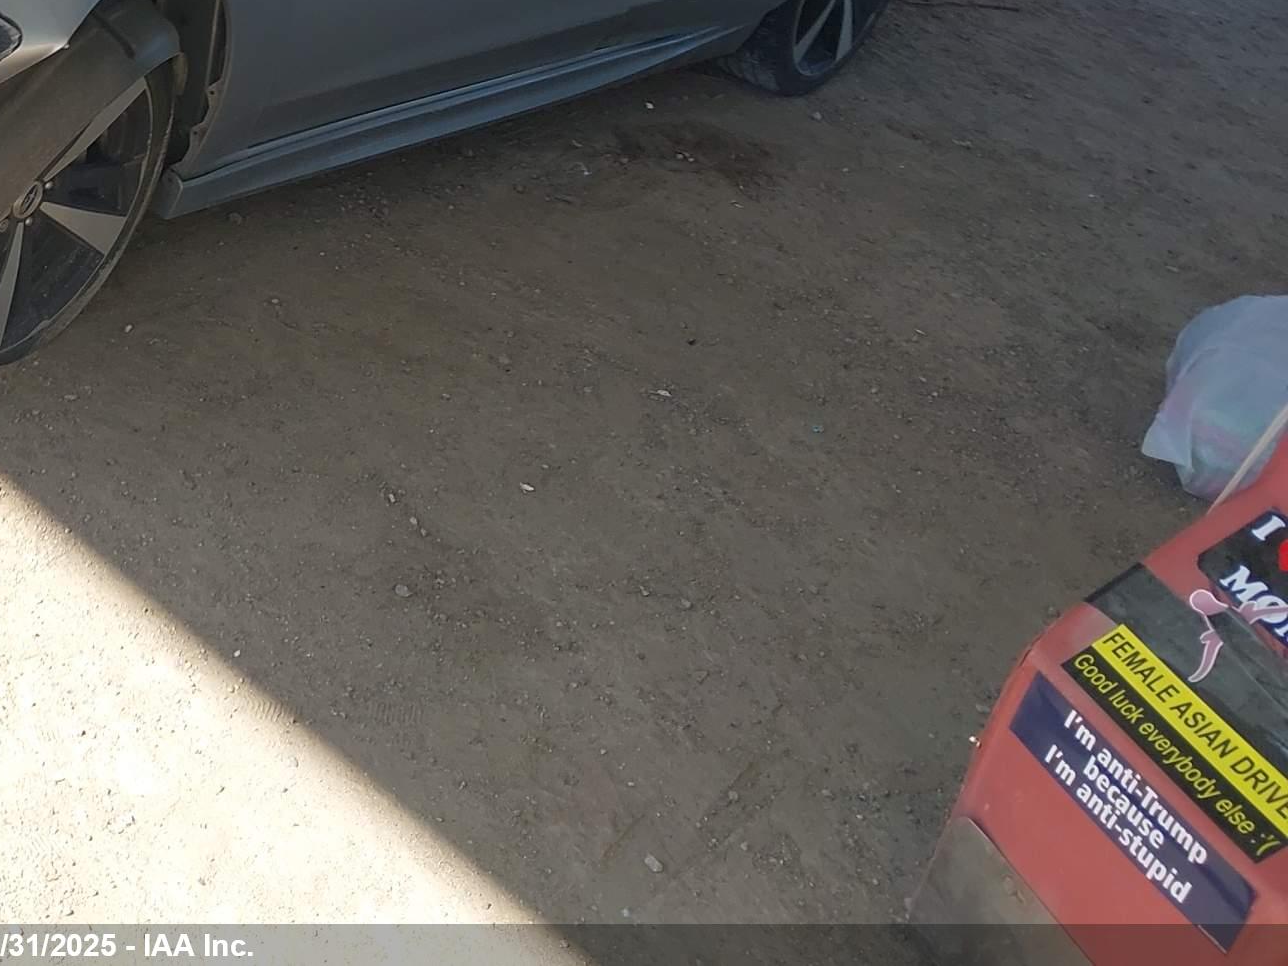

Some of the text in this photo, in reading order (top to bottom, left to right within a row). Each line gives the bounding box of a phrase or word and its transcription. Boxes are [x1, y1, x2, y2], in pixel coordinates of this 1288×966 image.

[1252, 515, 1286, 541] I
[1074, 654, 1117, 694] Good
[1108, 689, 1144, 724] luck
[1138, 722, 1221, 800] everybody
[1215, 798, 1255, 834] else
[1103, 632, 1181, 703] FEMALE
[1170, 701, 1239, 759] ASIAN
[1044, 744, 1193, 904] I'm anti-stupid
[1063, 709, 1208, 864] I'm anti-Trump
[1083, 755, 1165, 849] because
